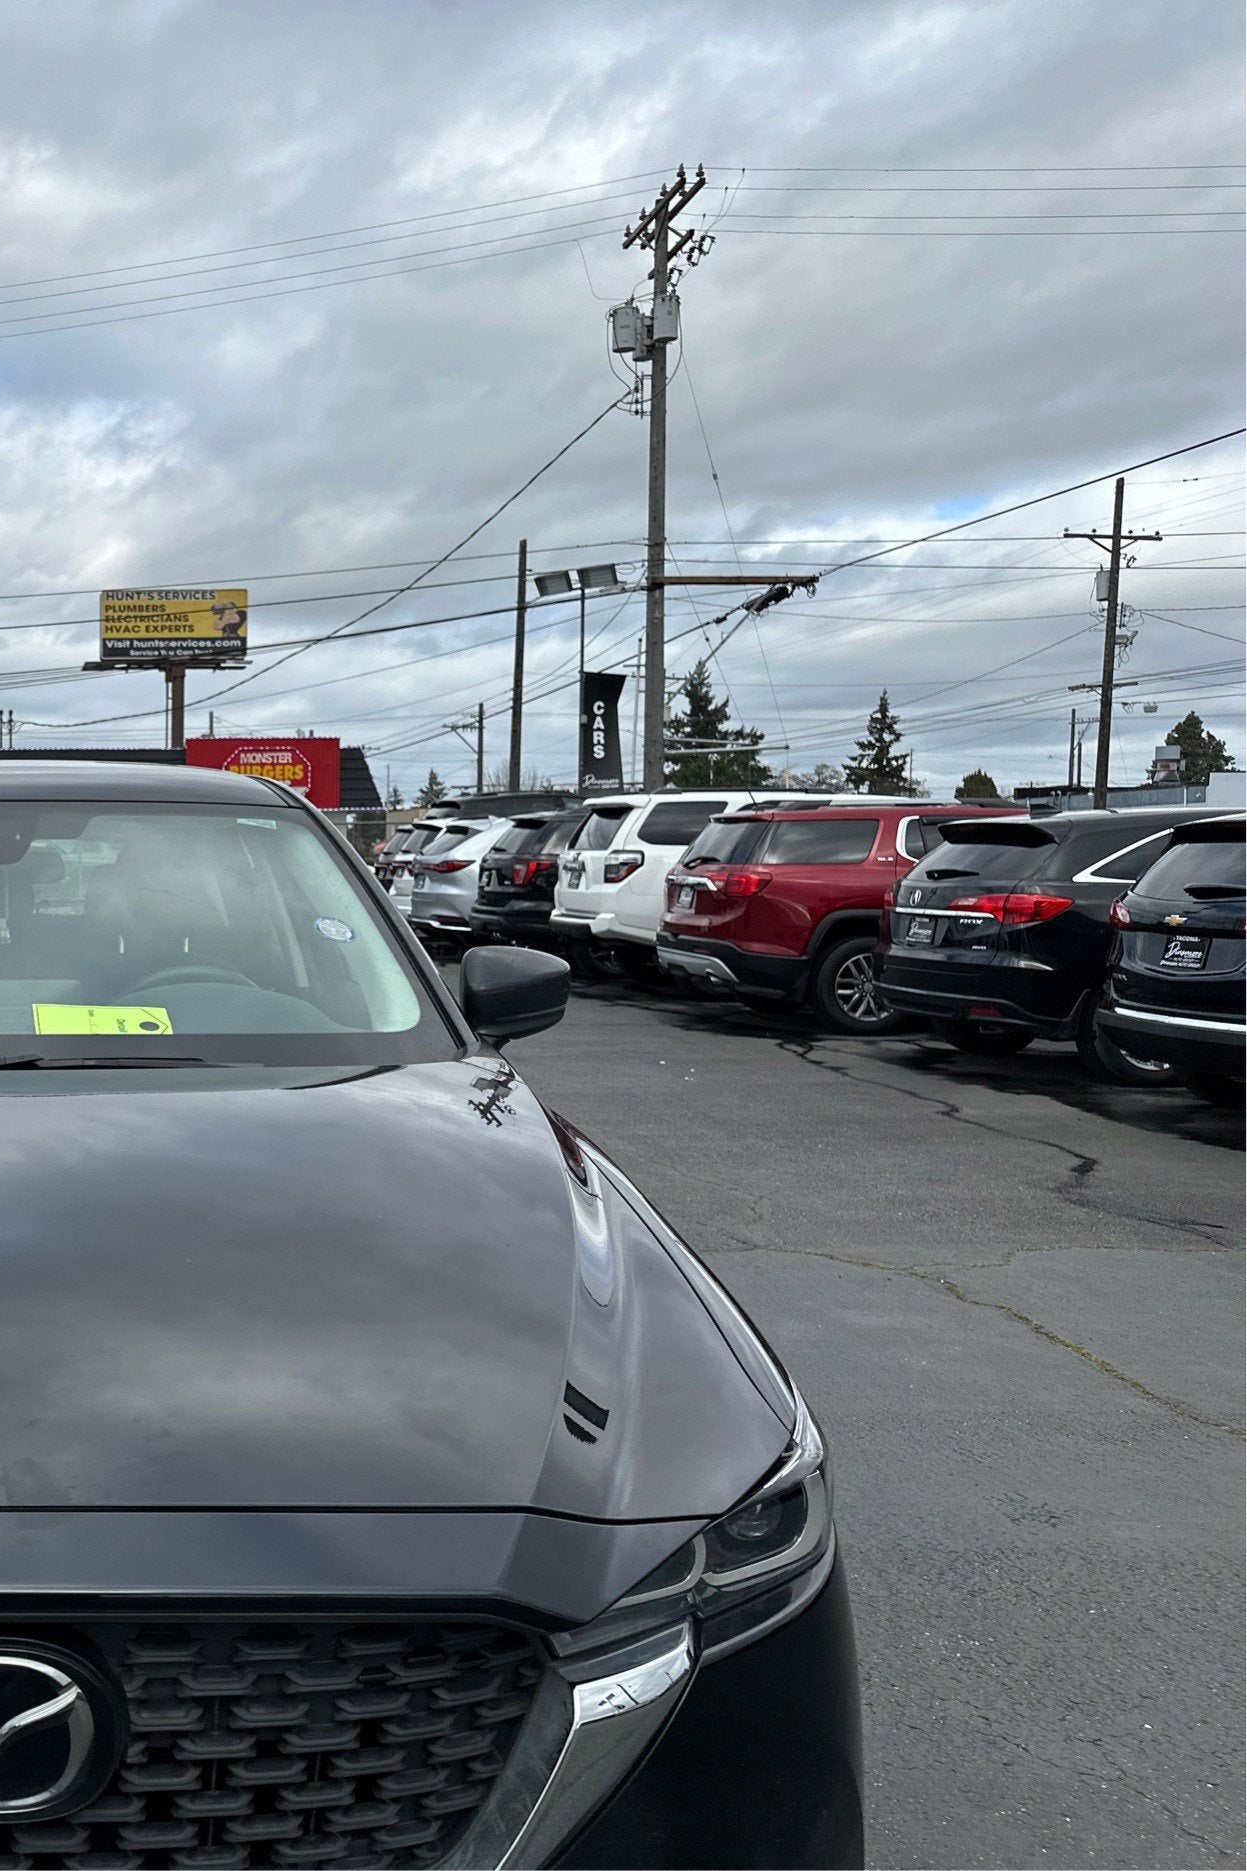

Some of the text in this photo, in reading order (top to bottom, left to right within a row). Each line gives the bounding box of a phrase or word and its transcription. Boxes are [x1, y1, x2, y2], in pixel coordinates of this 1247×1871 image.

[106, 591, 216, 600] HUNT'S SERVICES
[105, 604, 166, 613] PLUMBERS
[104, 614, 190, 623] ELECTRICIANS
[105, 625, 195, 633] HVAC EXPERTS
[105, 639, 131, 648] Visit
[593, 701, 605, 759] CARS
[240, 752, 292, 764] MONSTER
